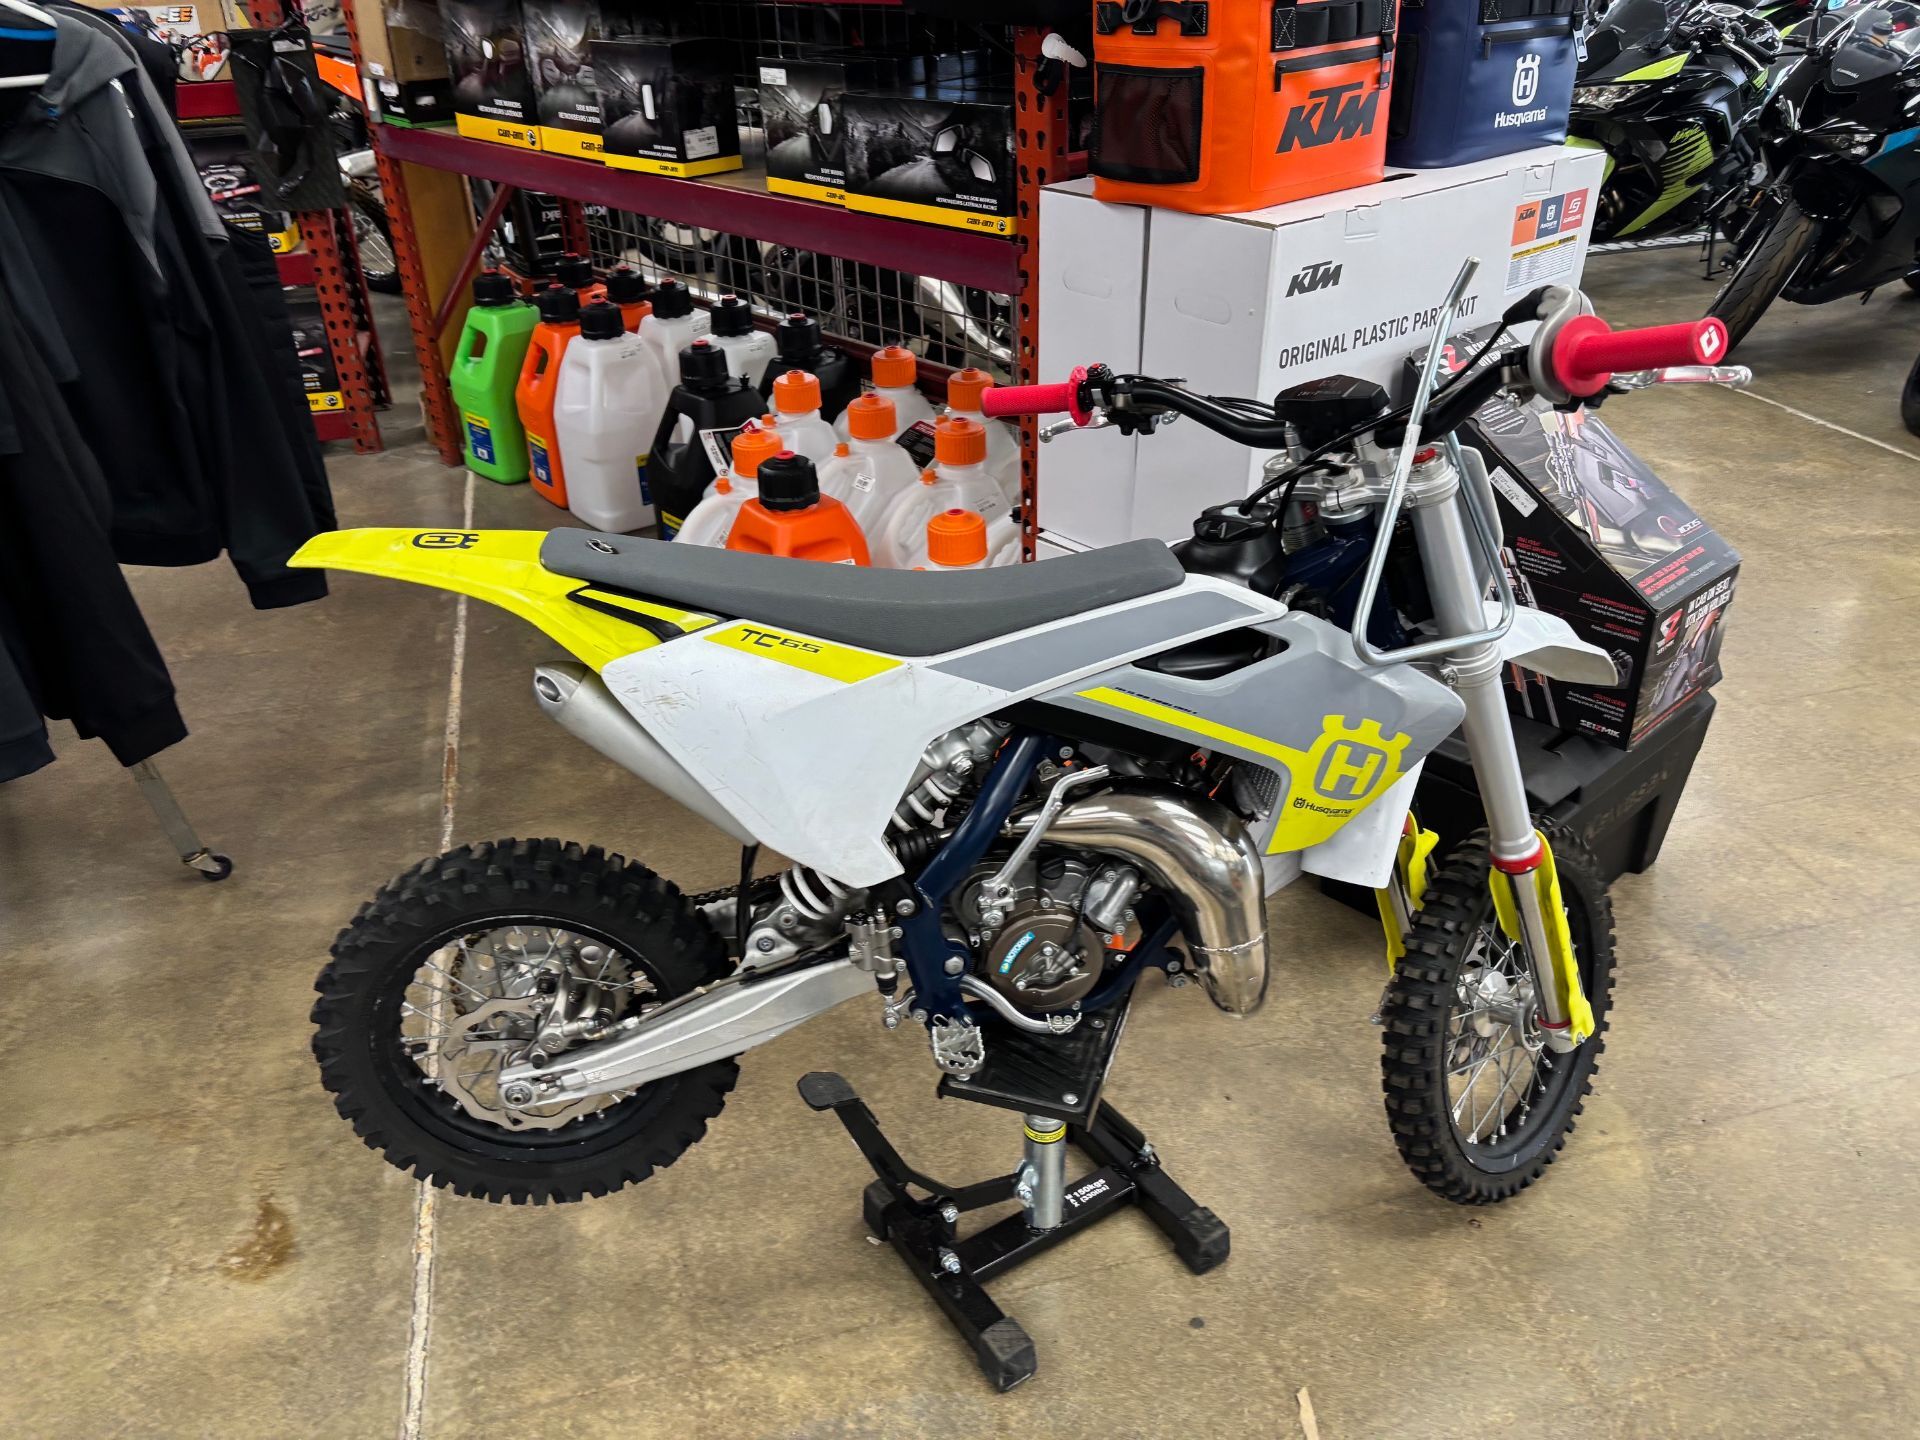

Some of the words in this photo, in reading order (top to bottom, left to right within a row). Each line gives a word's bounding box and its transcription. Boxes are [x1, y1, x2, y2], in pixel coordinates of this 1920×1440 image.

[1275, 81, 1380, 154] KTM
[1494, 109, 1546, 129] Husqvarna
[1285, 260, 1343, 298] KTM
[1279, 333, 1348, 369] ORIGINAL
[1352, 315, 1409, 350] PLASTIC
[1412, 305, 1446, 332] PART
[1456, 295, 1479, 319] KIT
[1305, 803, 1355, 815] Husqvarna
[1006, 932, 1032, 964] MOTOREX
[1073, 1178, 1107, 1199] 150kgs
